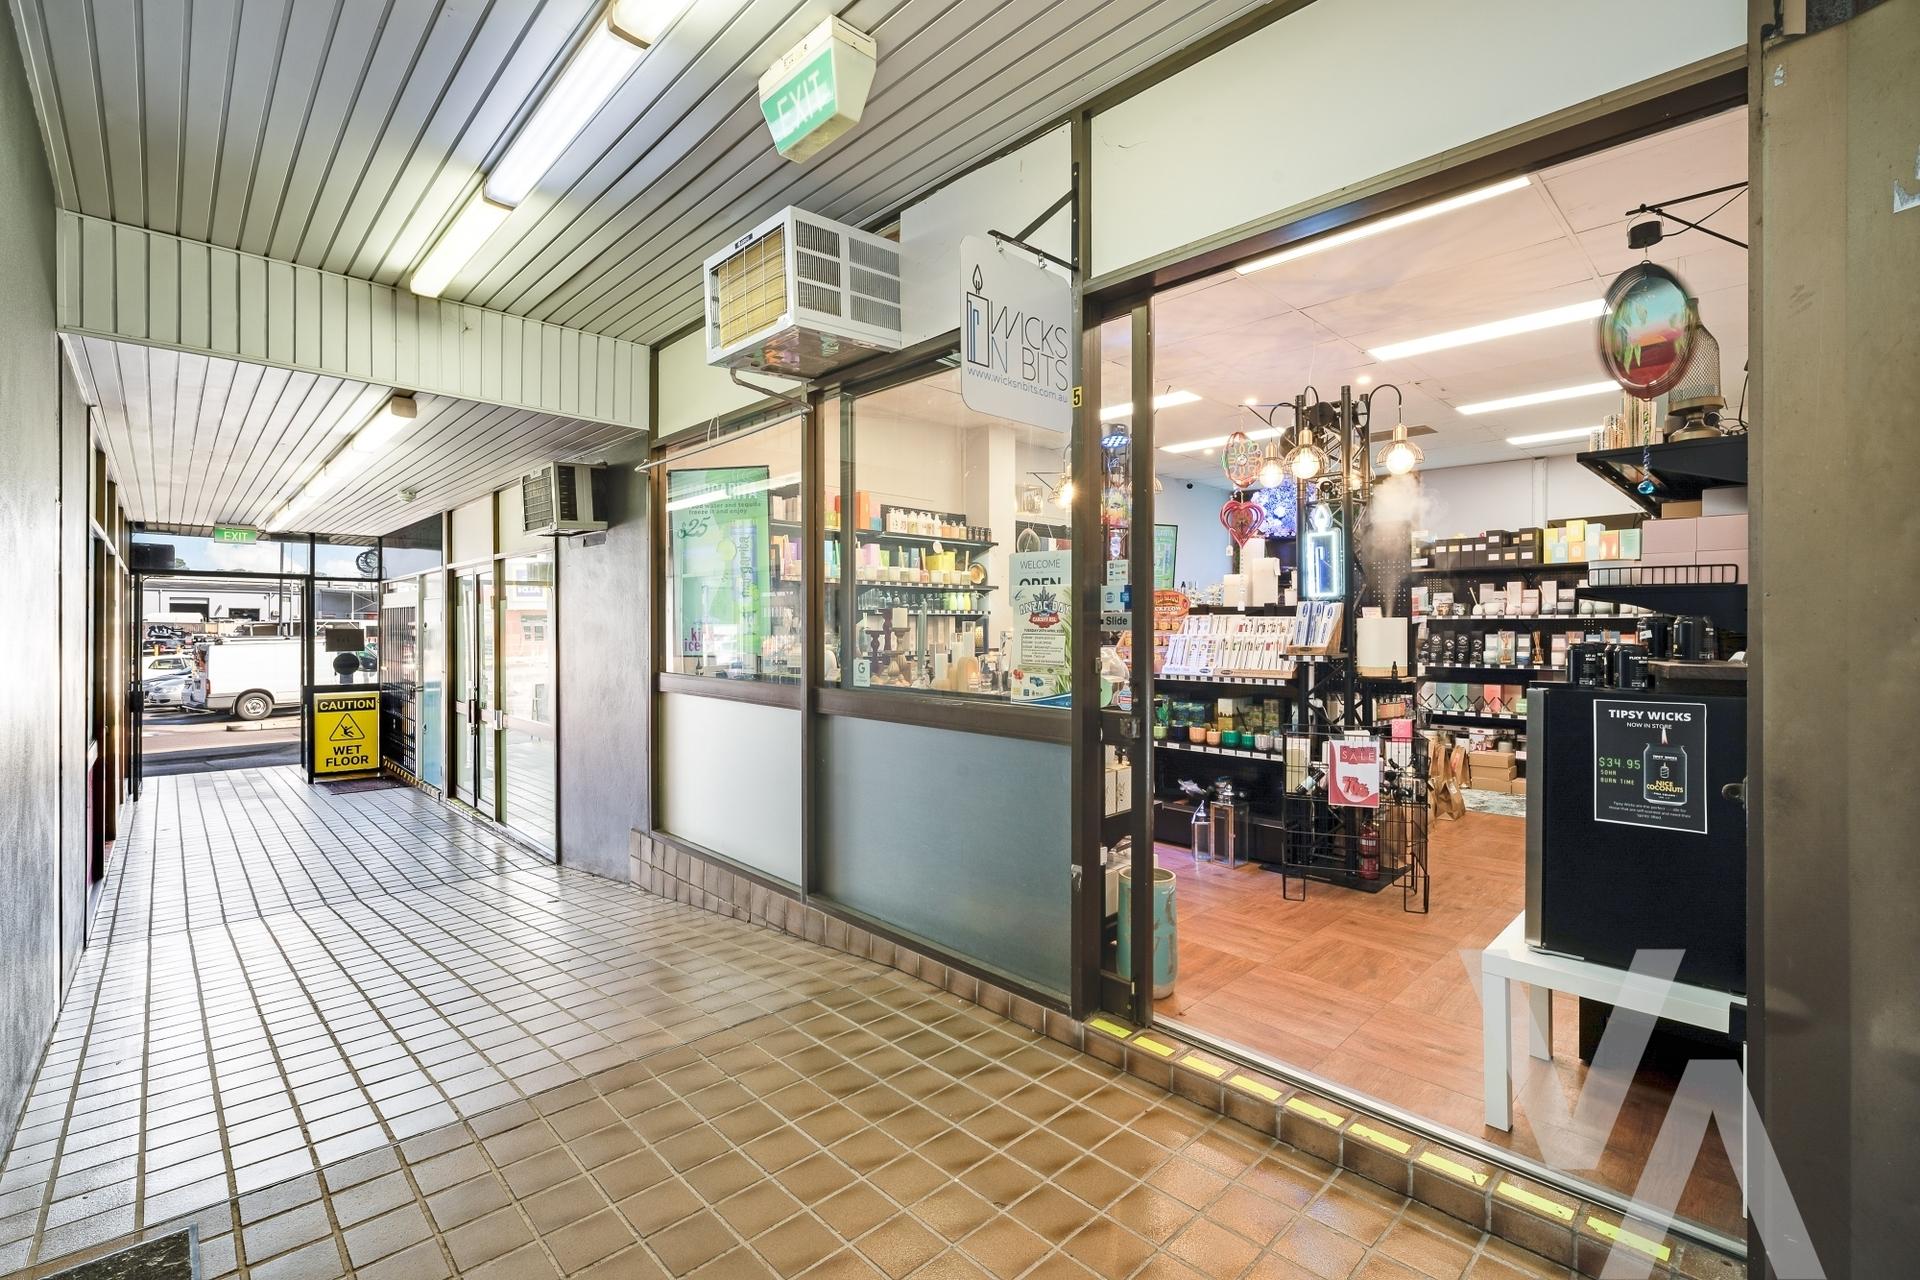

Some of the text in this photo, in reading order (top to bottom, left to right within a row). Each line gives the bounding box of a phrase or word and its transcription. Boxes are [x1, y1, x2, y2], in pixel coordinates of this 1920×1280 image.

[777, 69, 822, 134] EXIT
[990, 300, 1069, 359] WICKS
[1022, 346, 1069, 391] BITS
[967, 366, 1069, 403] www.wicksnbits.com.au
[677, 516, 711, 539] $25
[223, 531, 248, 541] EXIT
[1019, 558, 1062, 570] WELCOME
[1106, 616, 1128, 625] Slide
[319, 699, 375, 711] CAUTION
[1608, 709, 1692, 722] TIPSY WICKS
[333, 745, 362, 756] WET
[1342, 751, 1375, 761] SALE
[326, 755, 369, 767] FLOOR
[1598, 757, 1641, 770] $34.95
[1646, 784, 1684, 793] COCONUTS
